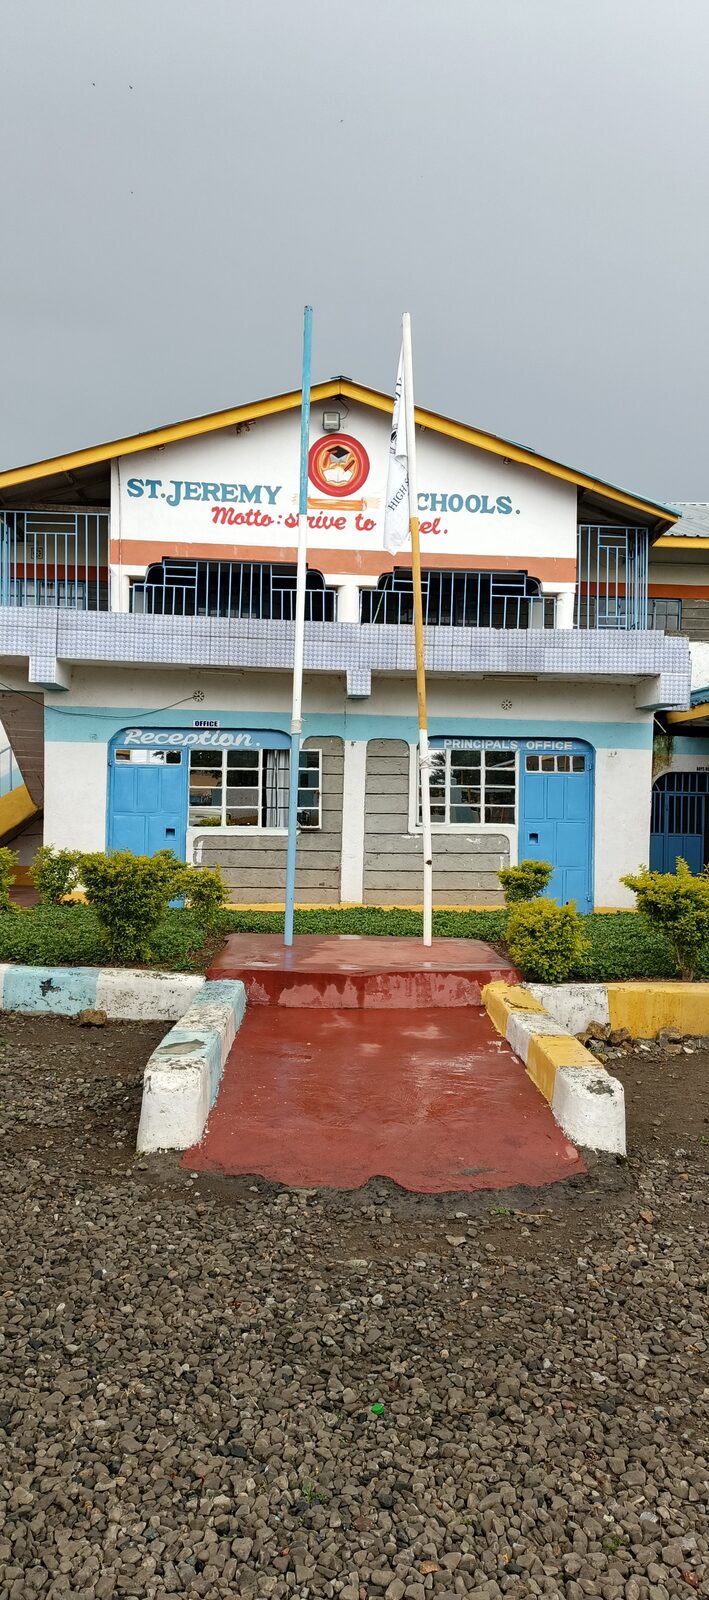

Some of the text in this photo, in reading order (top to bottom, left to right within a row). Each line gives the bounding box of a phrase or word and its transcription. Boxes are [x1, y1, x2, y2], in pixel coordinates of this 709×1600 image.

[387, 485, 407, 511] HIGH
[417, 492, 521, 515] CHOOLS.
[355, 513, 377, 532] to
[123, 728, 261, 747] Reception.
